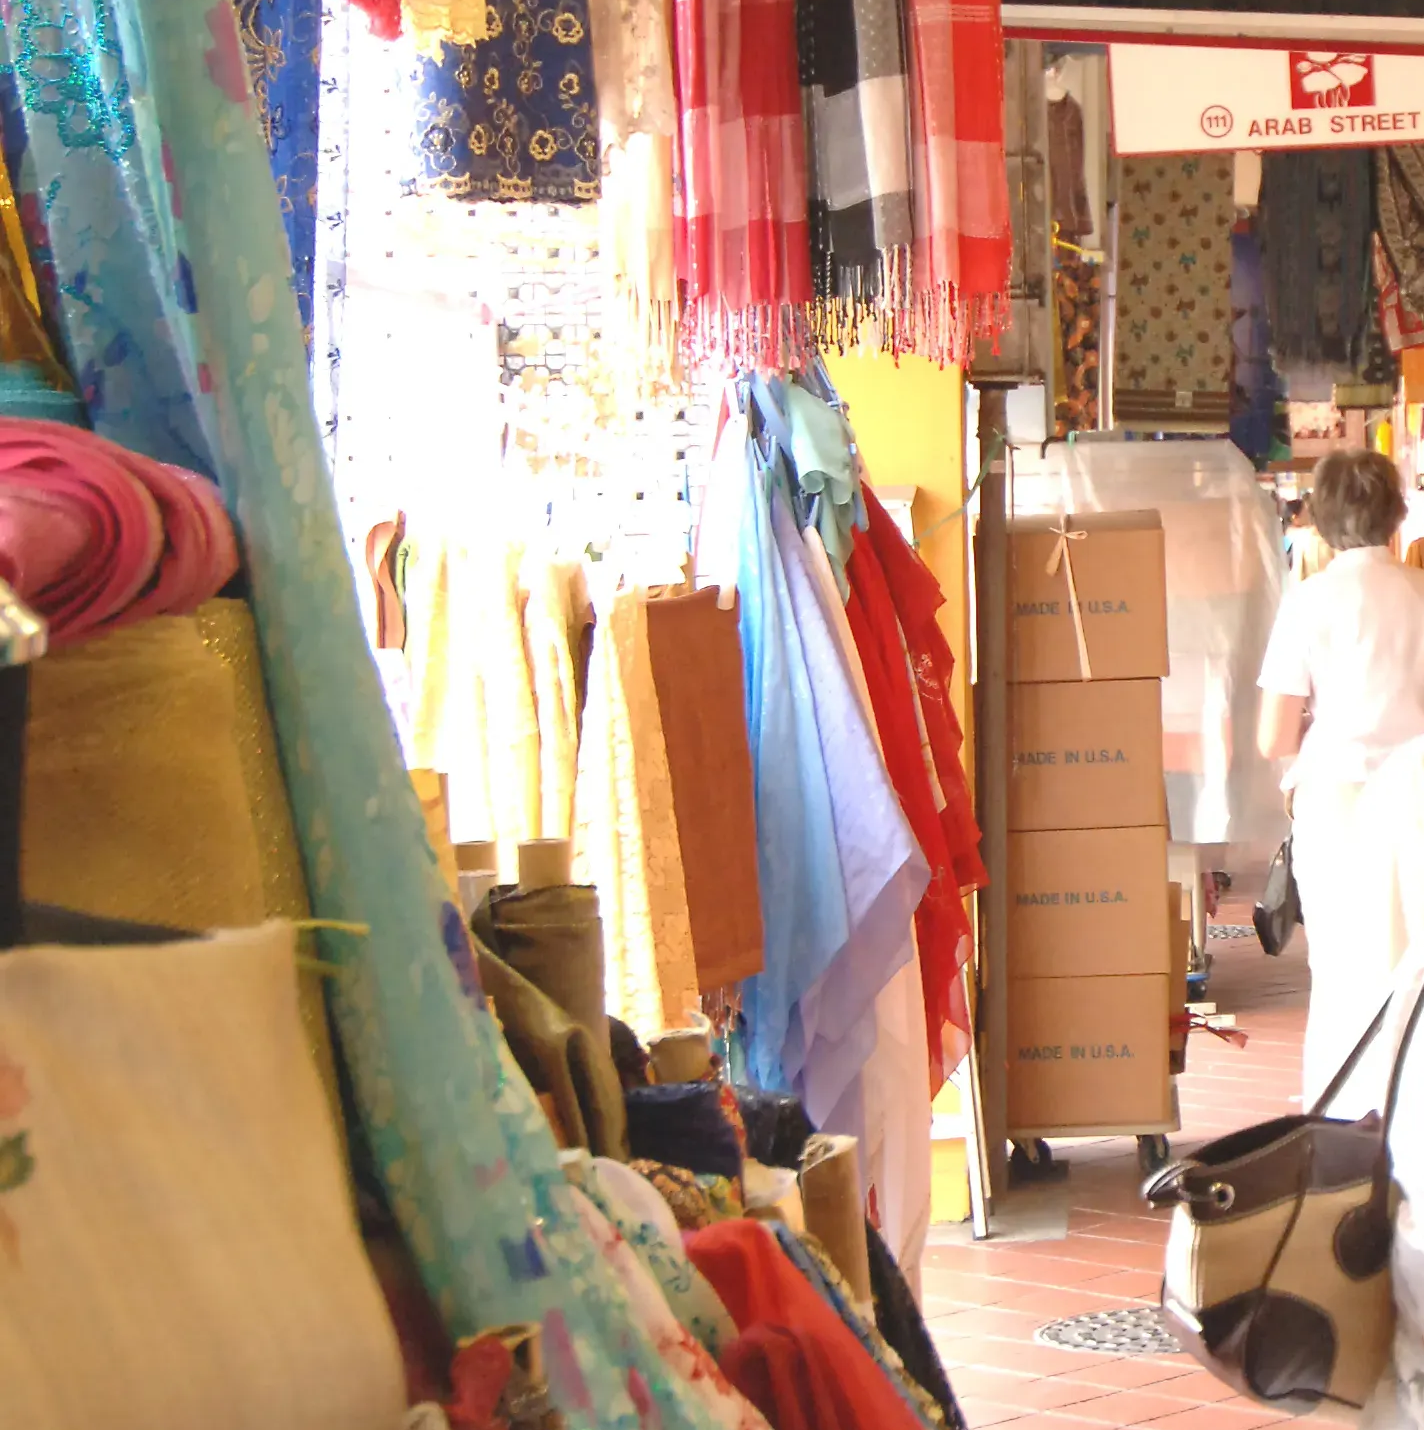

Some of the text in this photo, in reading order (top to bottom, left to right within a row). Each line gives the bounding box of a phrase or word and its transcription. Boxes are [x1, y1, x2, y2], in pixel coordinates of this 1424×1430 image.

[1206, 114, 1228, 130] 111
[1249, 114, 1319, 138] ARAB
[1330, 111, 1421, 134] STREET
[1016, 601, 1060, 615] MADE
[1064, 750, 1079, 763] IN
[1085, 749, 1129, 763] U.S.A.
[1016, 890, 1128, 905] MADE IN U.S.A.
[1018, 1044, 1135, 1059] MADE IN U.S.A.
